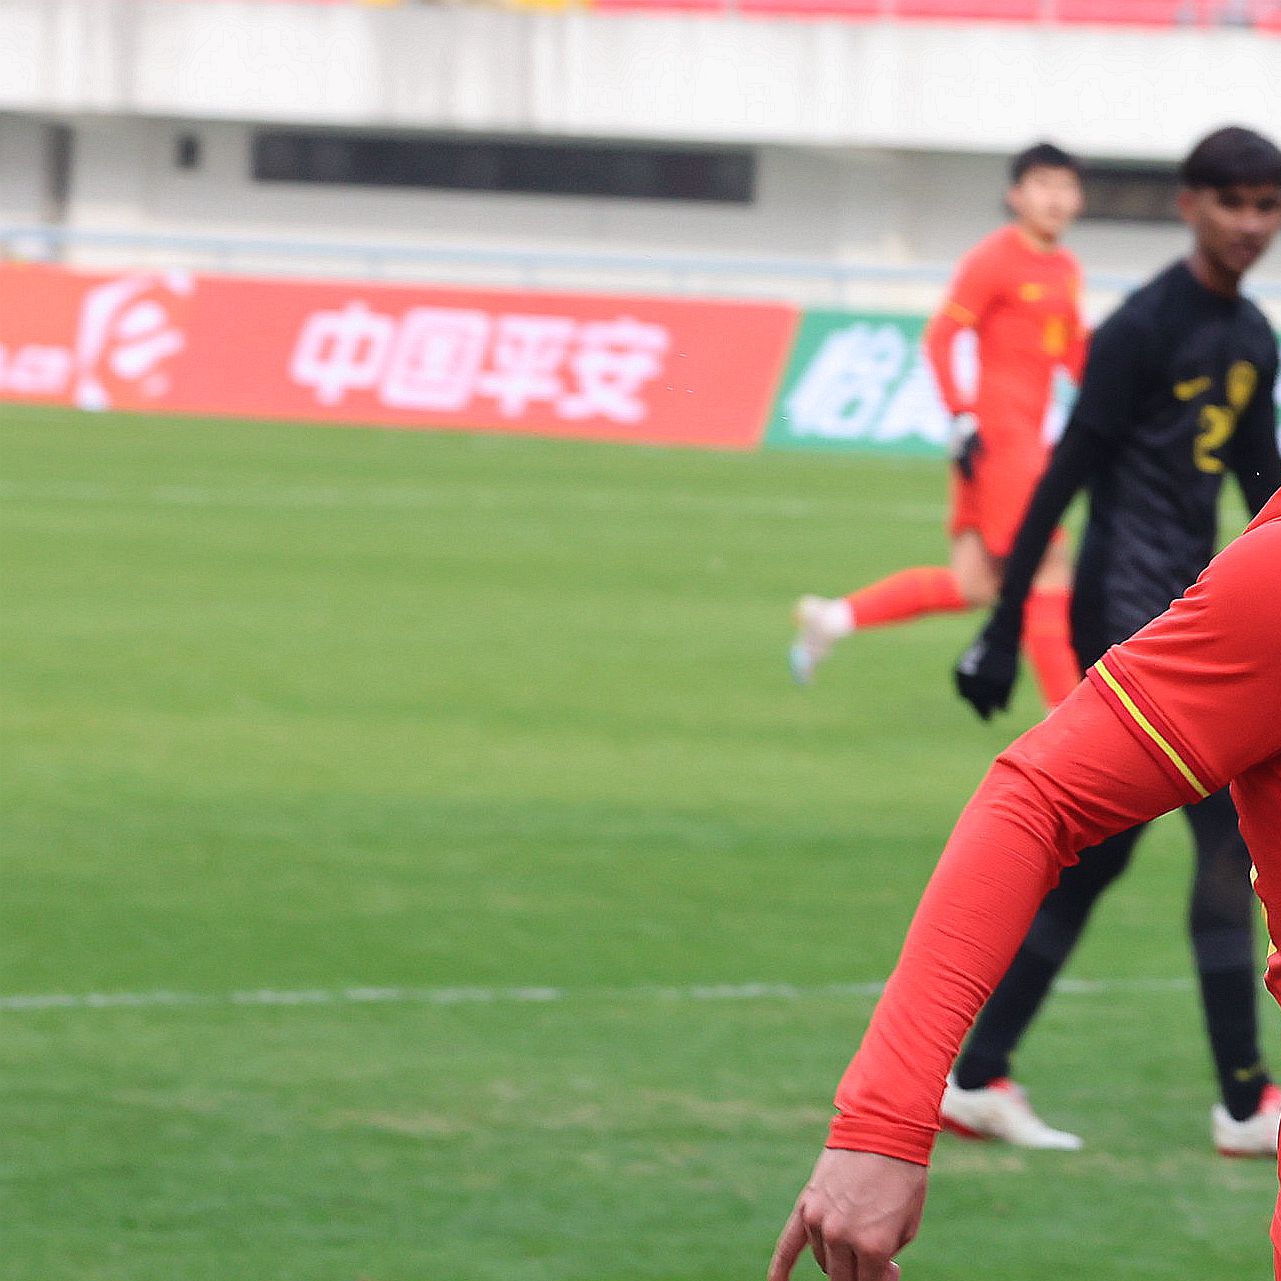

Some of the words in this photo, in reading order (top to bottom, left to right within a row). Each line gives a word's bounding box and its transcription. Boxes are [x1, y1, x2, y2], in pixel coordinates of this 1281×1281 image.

[288, 300, 672, 424] 中国平安
[1192, 404, 1237, 474] 2
